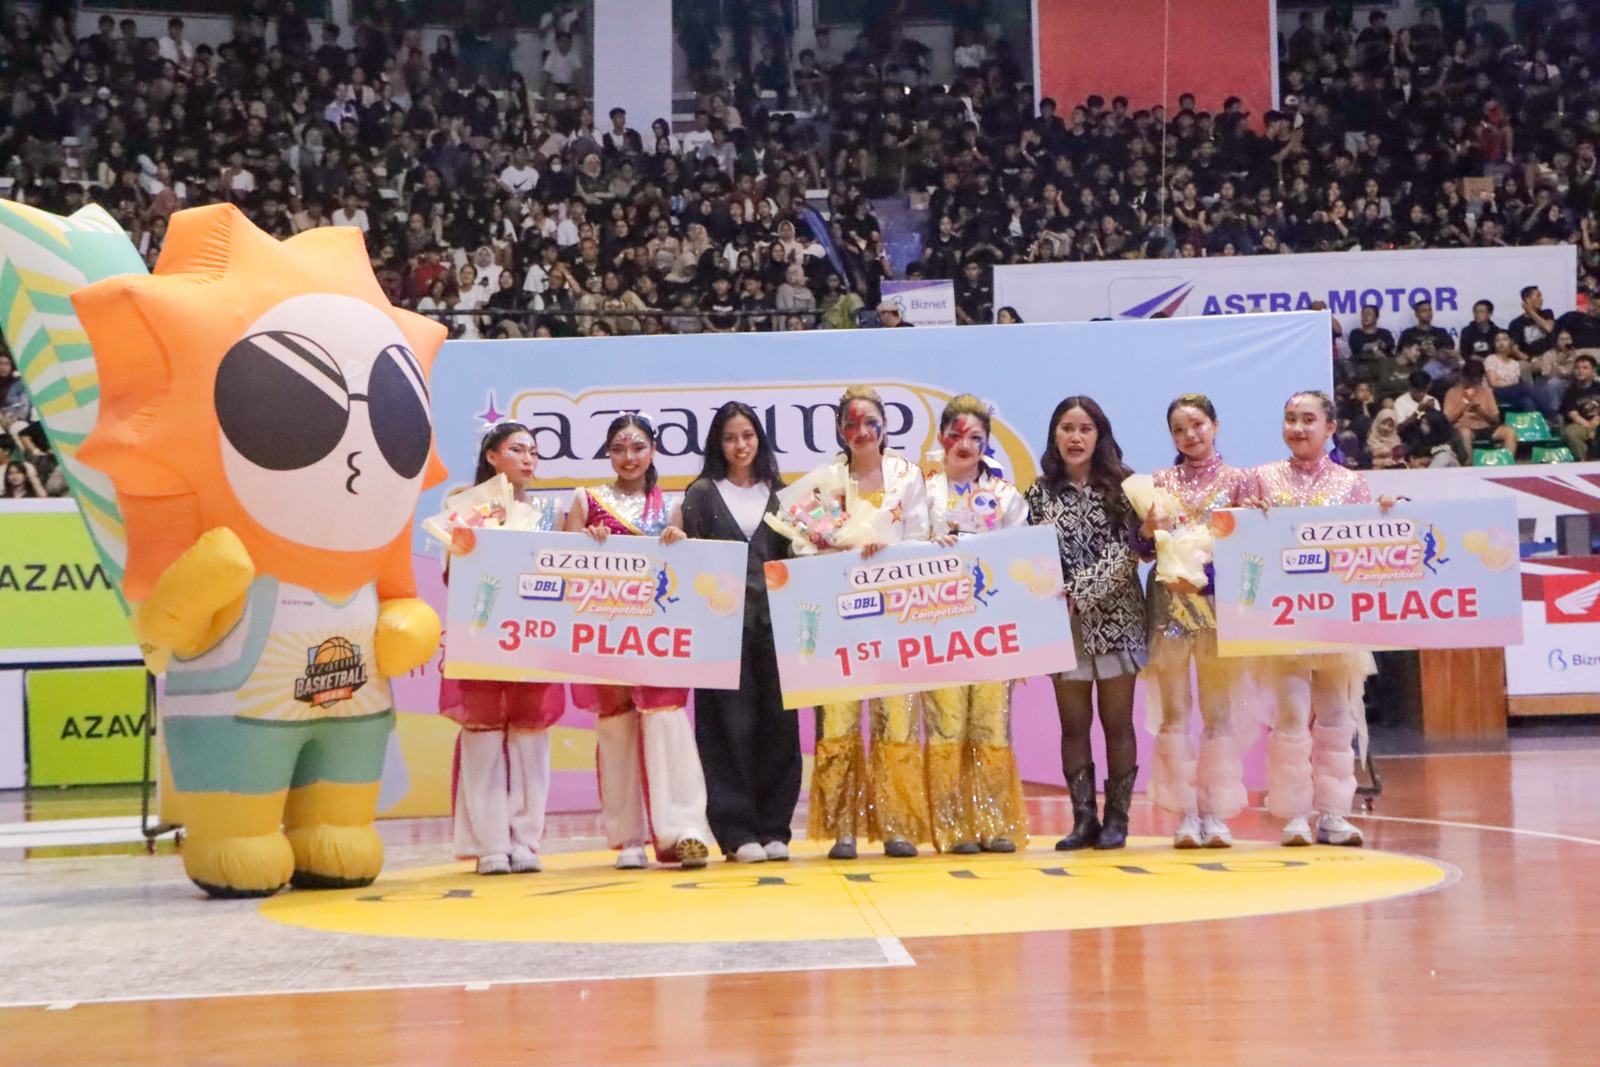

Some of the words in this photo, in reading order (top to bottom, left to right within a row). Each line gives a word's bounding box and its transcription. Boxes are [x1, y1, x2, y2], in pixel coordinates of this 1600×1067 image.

[911, 300, 946, 310] Biznet
[1202, 291, 1314, 316] ASTRA
[1328, 286, 1458, 314] MOTOR
[1302, 522, 1411, 541] azarine
[540, 553, 646, 573] azarine
[854, 557, 960, 585] azarine
[1297, 553, 1322, 566] DBL
[1331, 544, 1420, 581] DANCE
[1356, 570, 1424, 585] Competition
[533, 581, 558, 593] DBL
[567, 578, 652, 611] DANCE
[853, 596, 877, 610] DBL
[885, 577, 970, 621] DANCE
[1271, 592, 1335, 626] 2ND
[1351, 587, 1478, 622] PLACE
[588, 603, 653, 619] Competition
[911, 604, 976, 622] Competition
[498, 619, 557, 651] 3RD
[571, 623, 692, 658] PLACE
[834, 640, 882, 677] 1ST
[898, 623, 1021, 669] PLACE
[295, 665, 367, 698] BASKETBALL
